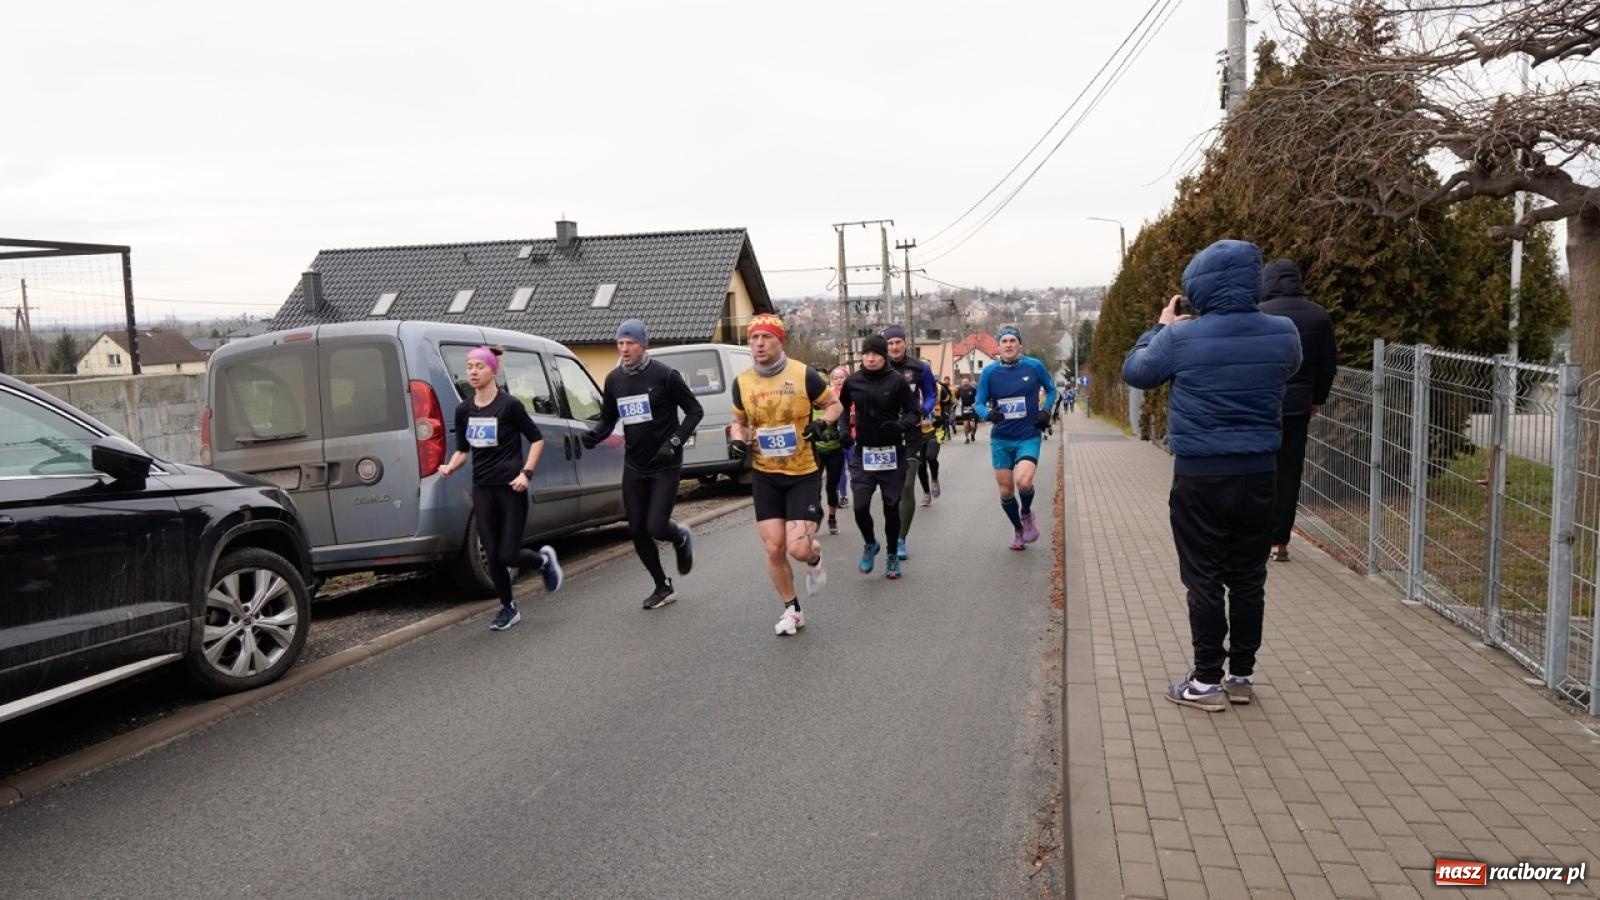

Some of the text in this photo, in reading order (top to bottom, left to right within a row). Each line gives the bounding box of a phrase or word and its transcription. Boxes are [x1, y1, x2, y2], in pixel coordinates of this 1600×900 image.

[623, 402, 645, 416] 188
[1005, 403, 1017, 413] 97
[470, 426, 486, 439] 76
[767, 434, 786, 449] 38
[869, 453, 891, 464] 133
